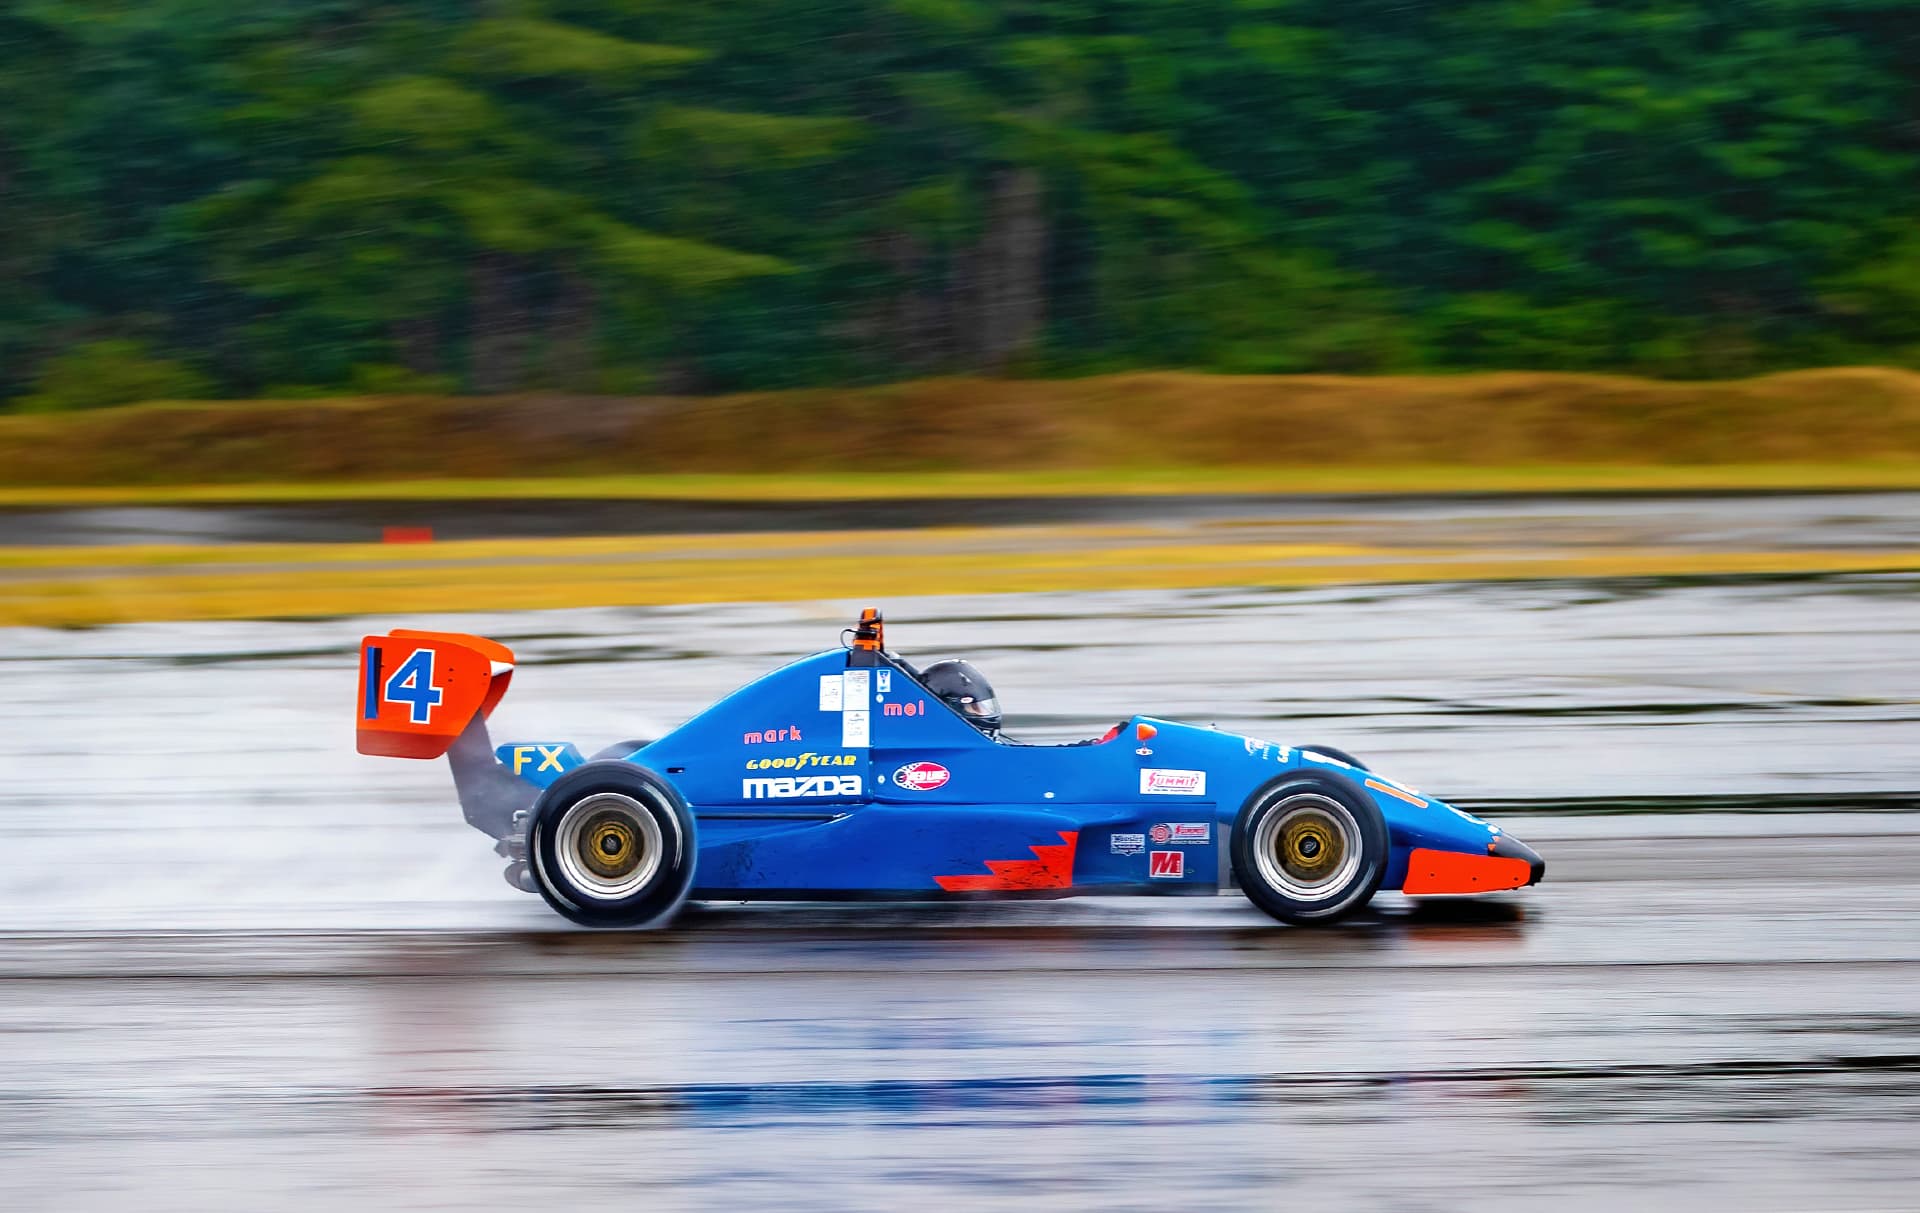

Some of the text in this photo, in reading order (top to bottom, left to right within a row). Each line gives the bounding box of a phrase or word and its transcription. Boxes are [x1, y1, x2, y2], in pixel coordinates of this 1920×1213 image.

[744, 725, 802, 744] mark
[512, 745, 566, 776] FX
[746, 752, 857, 770] GOODYEAR
